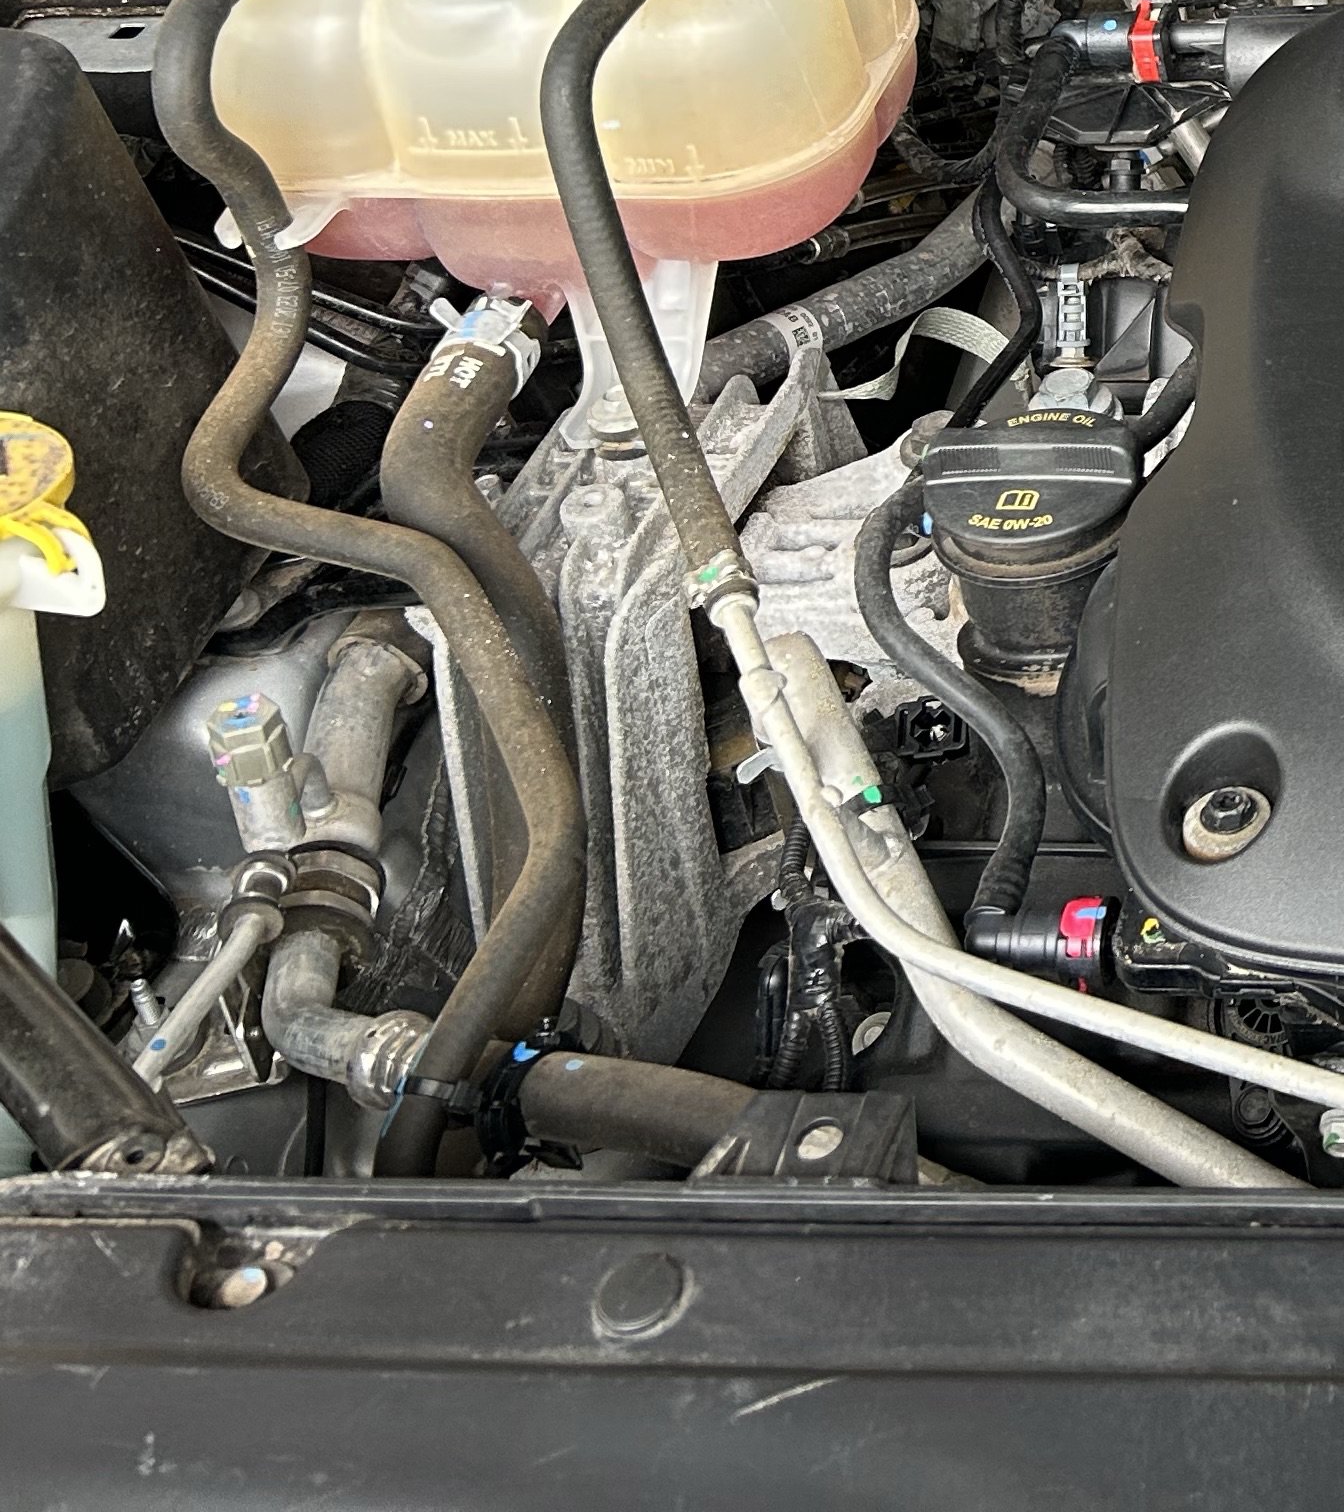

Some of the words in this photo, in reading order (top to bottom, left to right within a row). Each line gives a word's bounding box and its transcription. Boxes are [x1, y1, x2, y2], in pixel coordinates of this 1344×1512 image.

[449, 355, 484, 389] HOT
[1006, 412, 1071, 428] ENGINE
[1073, 414, 1096, 428] OIL
[968, 514, 1003, 530] SAE
[1003, 514, 1054, 531] 0W-20
